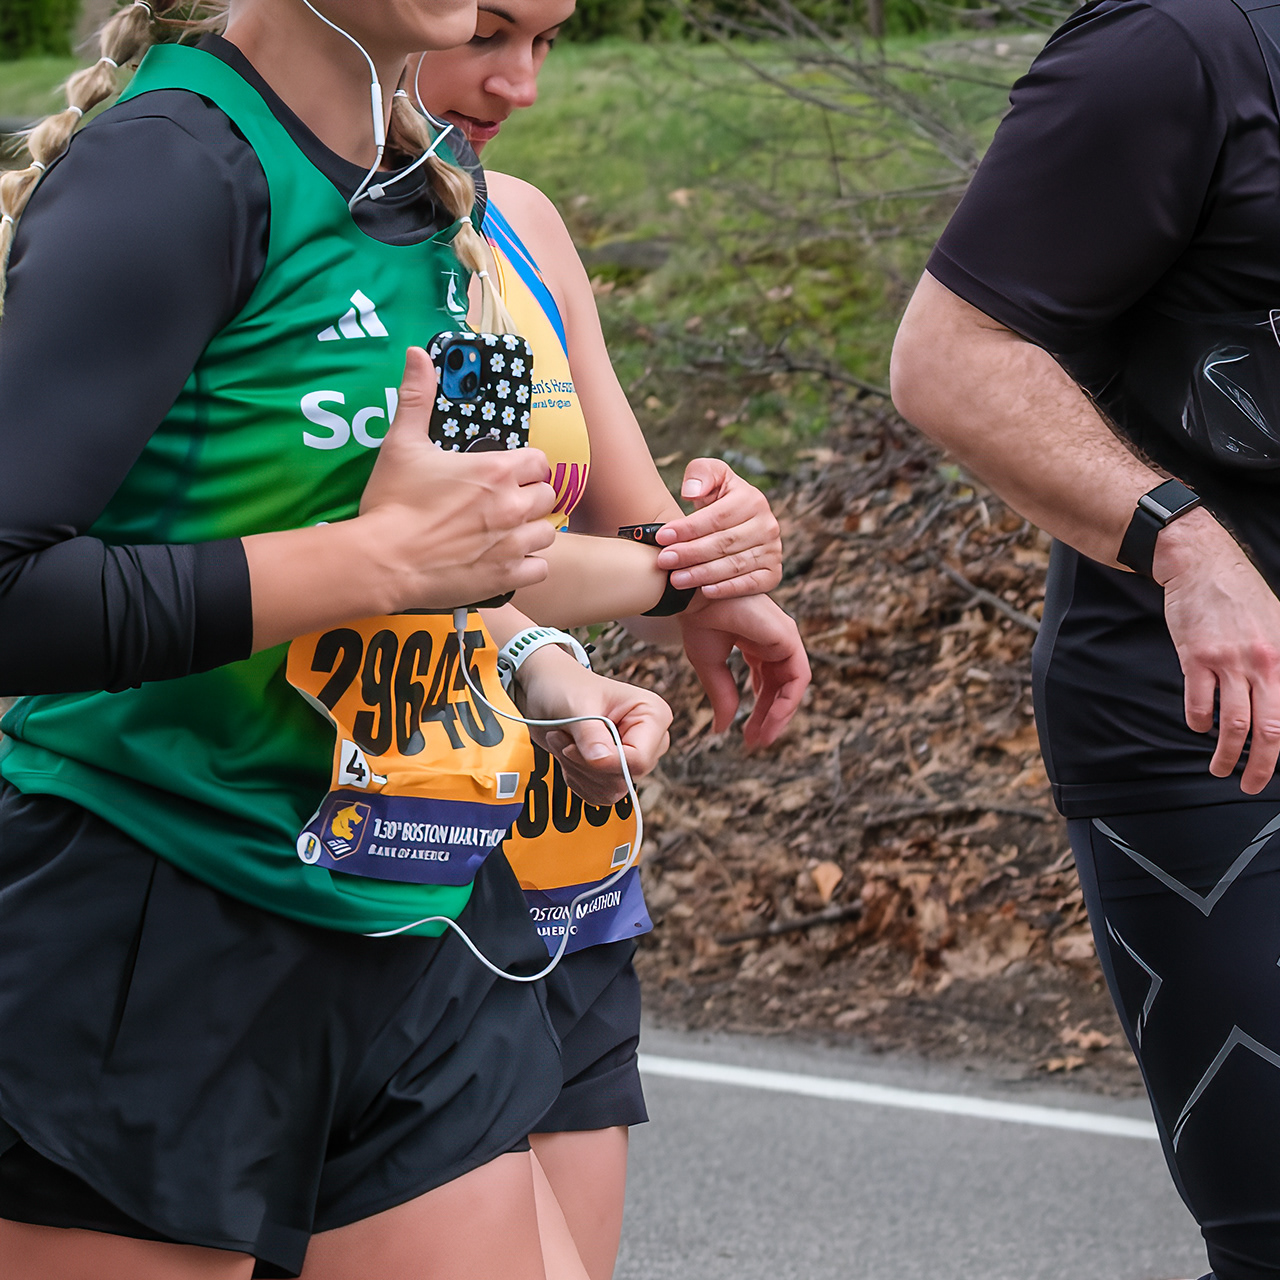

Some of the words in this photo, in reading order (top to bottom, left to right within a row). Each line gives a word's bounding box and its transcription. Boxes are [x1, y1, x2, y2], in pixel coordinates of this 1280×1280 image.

[300, 387, 399, 450] Sc
[310, 628, 505, 756] 29645
[346, 749, 366, 782] 4
[401, 822, 449, 844] BOSTON
